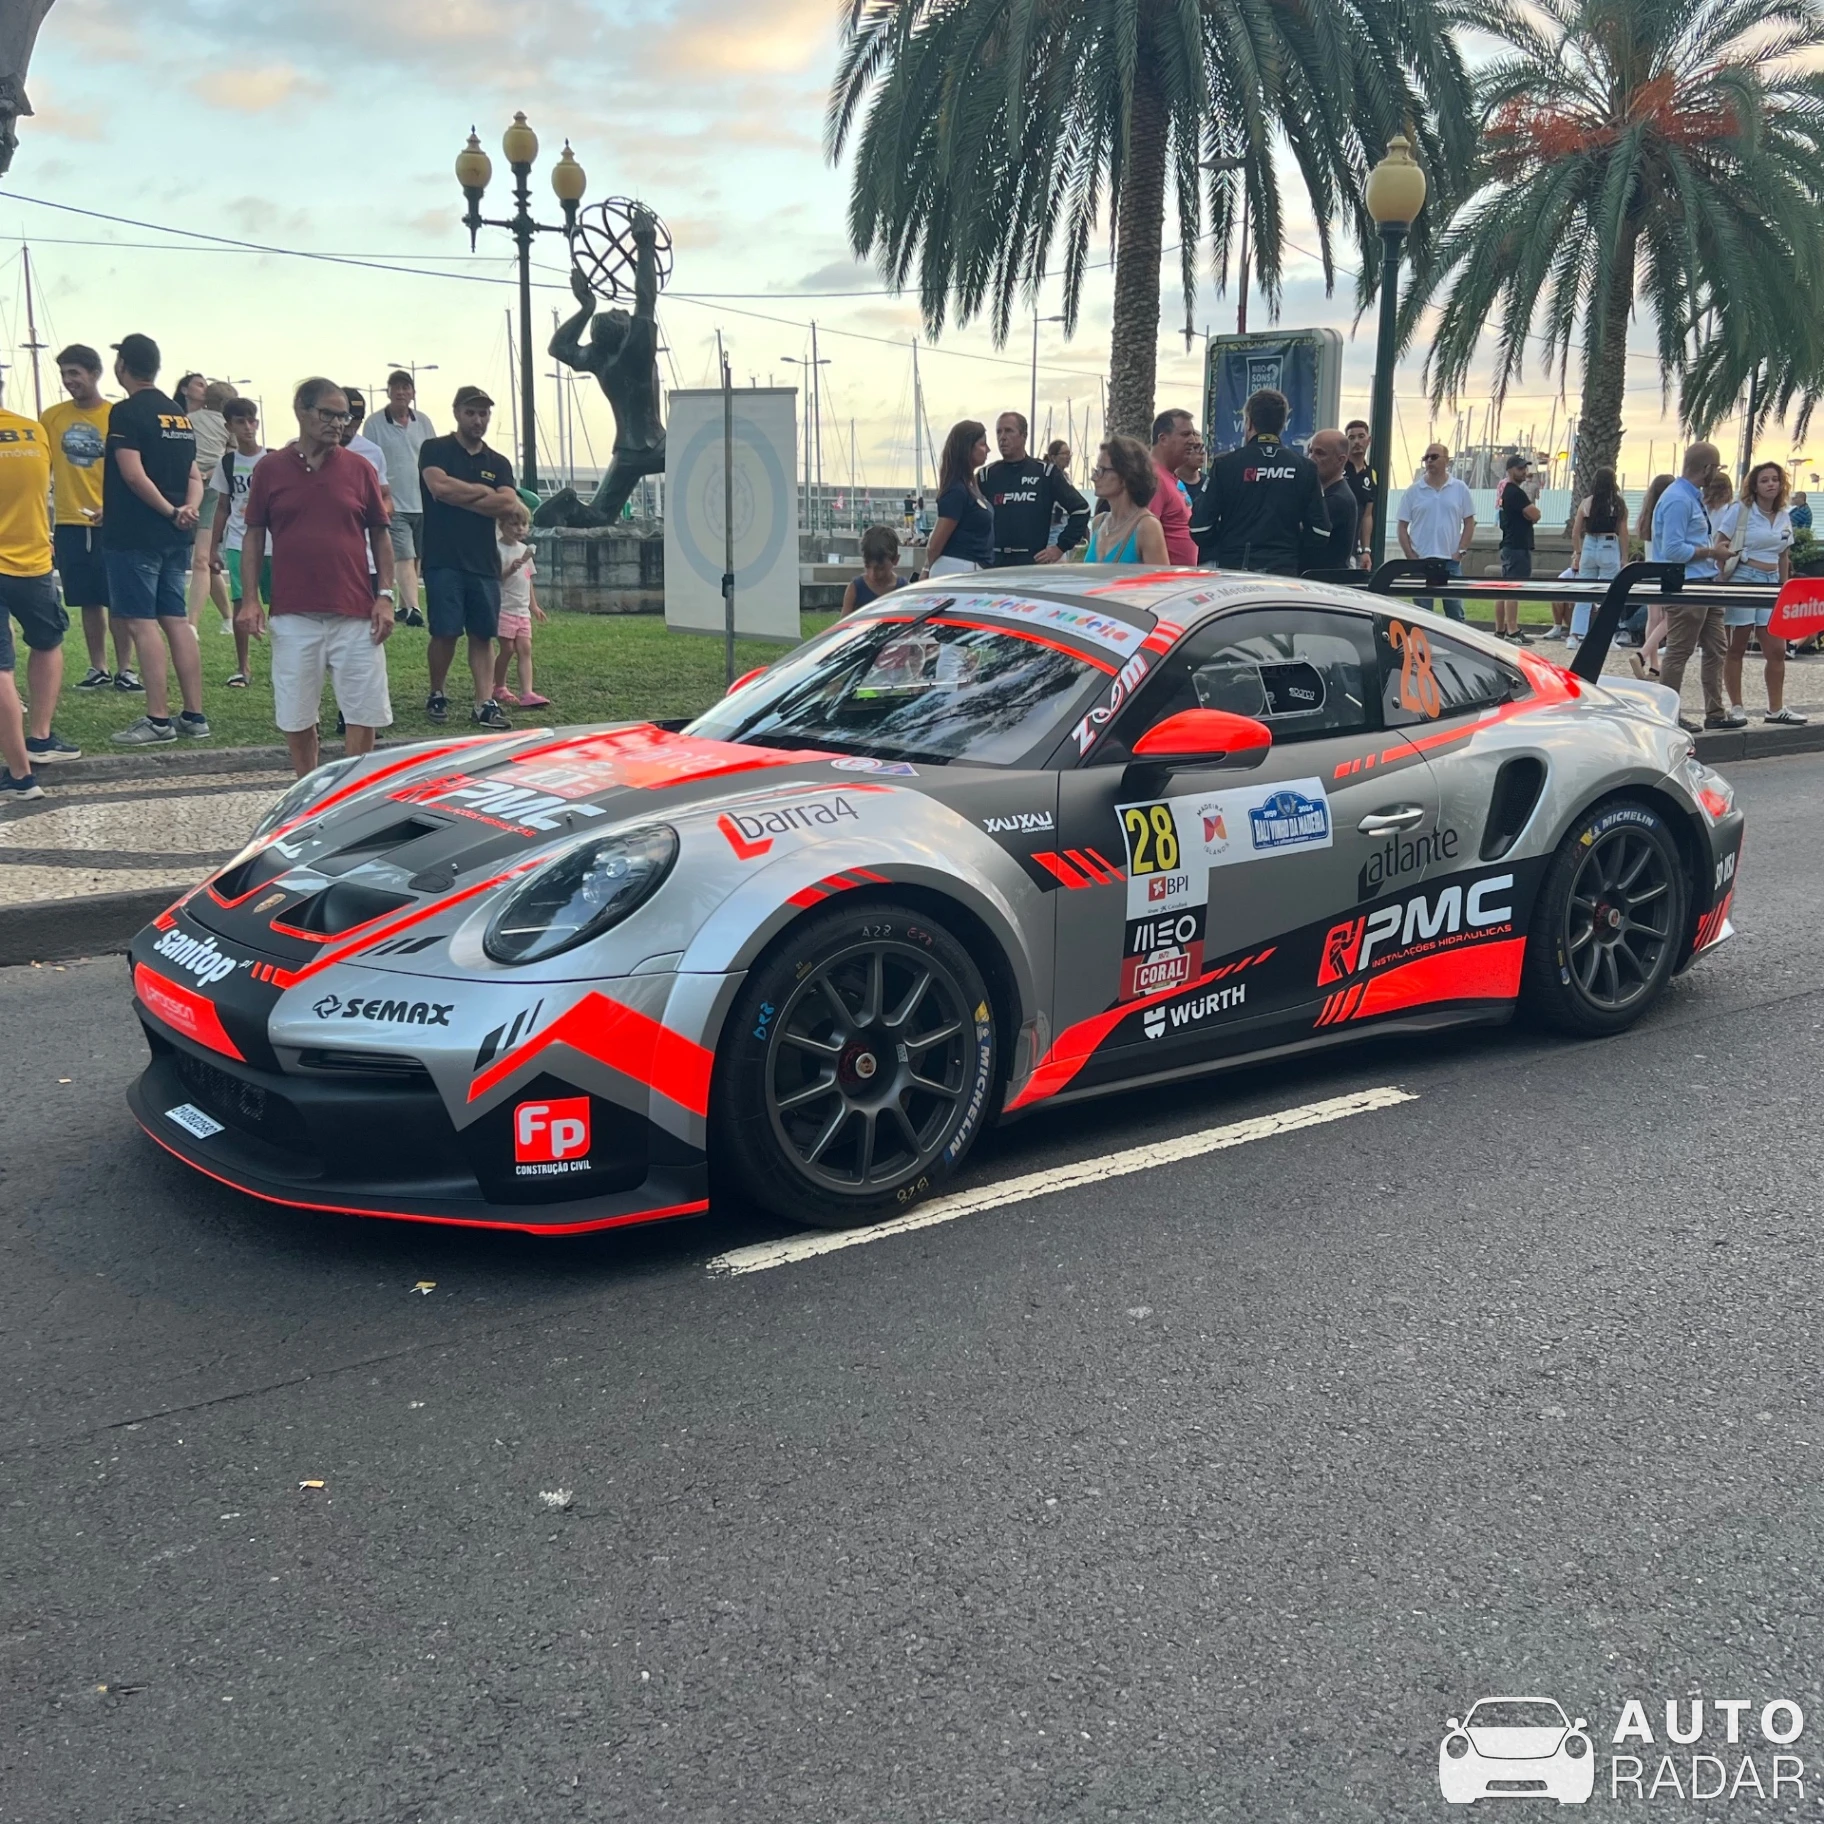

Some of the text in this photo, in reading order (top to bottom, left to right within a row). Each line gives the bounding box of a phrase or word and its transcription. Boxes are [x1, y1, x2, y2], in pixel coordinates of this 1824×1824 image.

[1251, 373, 1272, 383] SONS
[157, 414, 193, 430] FBI
[1256, 467, 1296, 482] PMC
[1003, 491, 1037, 505] PMC
[1222, 584, 1265, 596] Mendes
[1782, 596, 1824, 619] sanito
[1388, 619, 1441, 718] 28
[1288, 686, 1315, 700] sparco
[415, 781, 608, 831] PMC
[726, 796, 860, 839] barra4
[1196, 803, 1224, 817] MADEIRA
[1602, 811, 1655, 830] MICHELIN
[1125, 805, 1179, 875] 28
[1368, 826, 1459, 883] atlante
[1167, 875, 1189, 895] BPI
[1133, 914, 1197, 952] MEO
[1358, 873, 1514, 972] PMC
[153, 929, 238, 988] sanitop
[1372, 924, 1513, 968] INSTALAÇÕES HIDRÁULICAS
[1140, 959, 1185, 986] CORAL
[341, 999, 456, 1027] SEMAX
[949, 1046, 991, 1157] MICHELIN
[515, 1160, 591, 1175] CONSTRUÇÃO CIVIL
